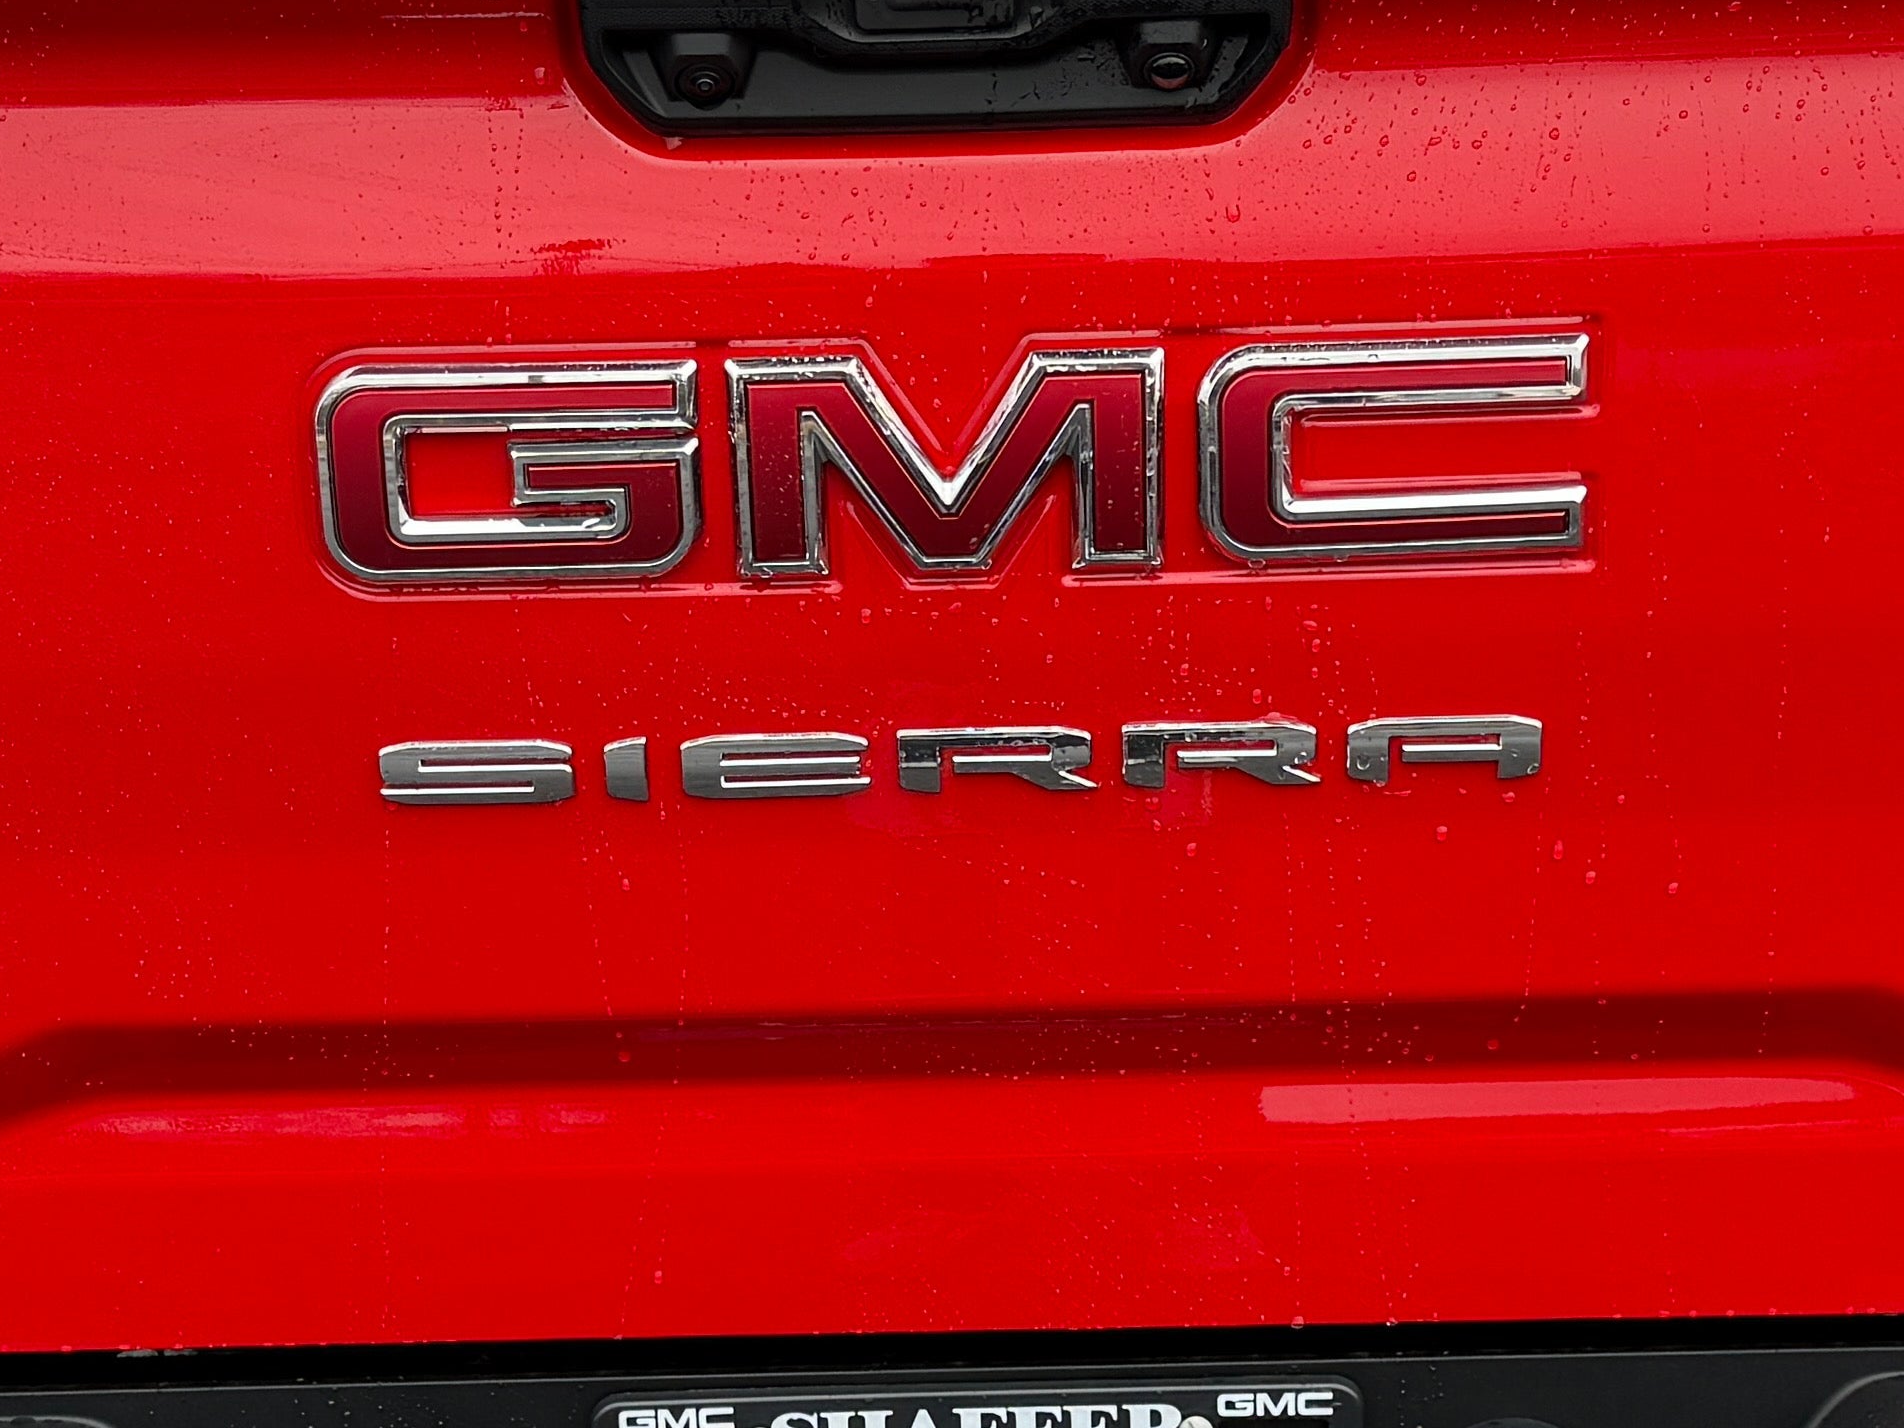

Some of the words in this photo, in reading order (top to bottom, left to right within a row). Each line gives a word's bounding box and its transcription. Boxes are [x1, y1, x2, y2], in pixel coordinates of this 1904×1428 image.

[314, 332, 1590, 582] GMC
[378, 714, 1542, 804] SIERRA
[1216, 1391, 1334, 1417] GMC
